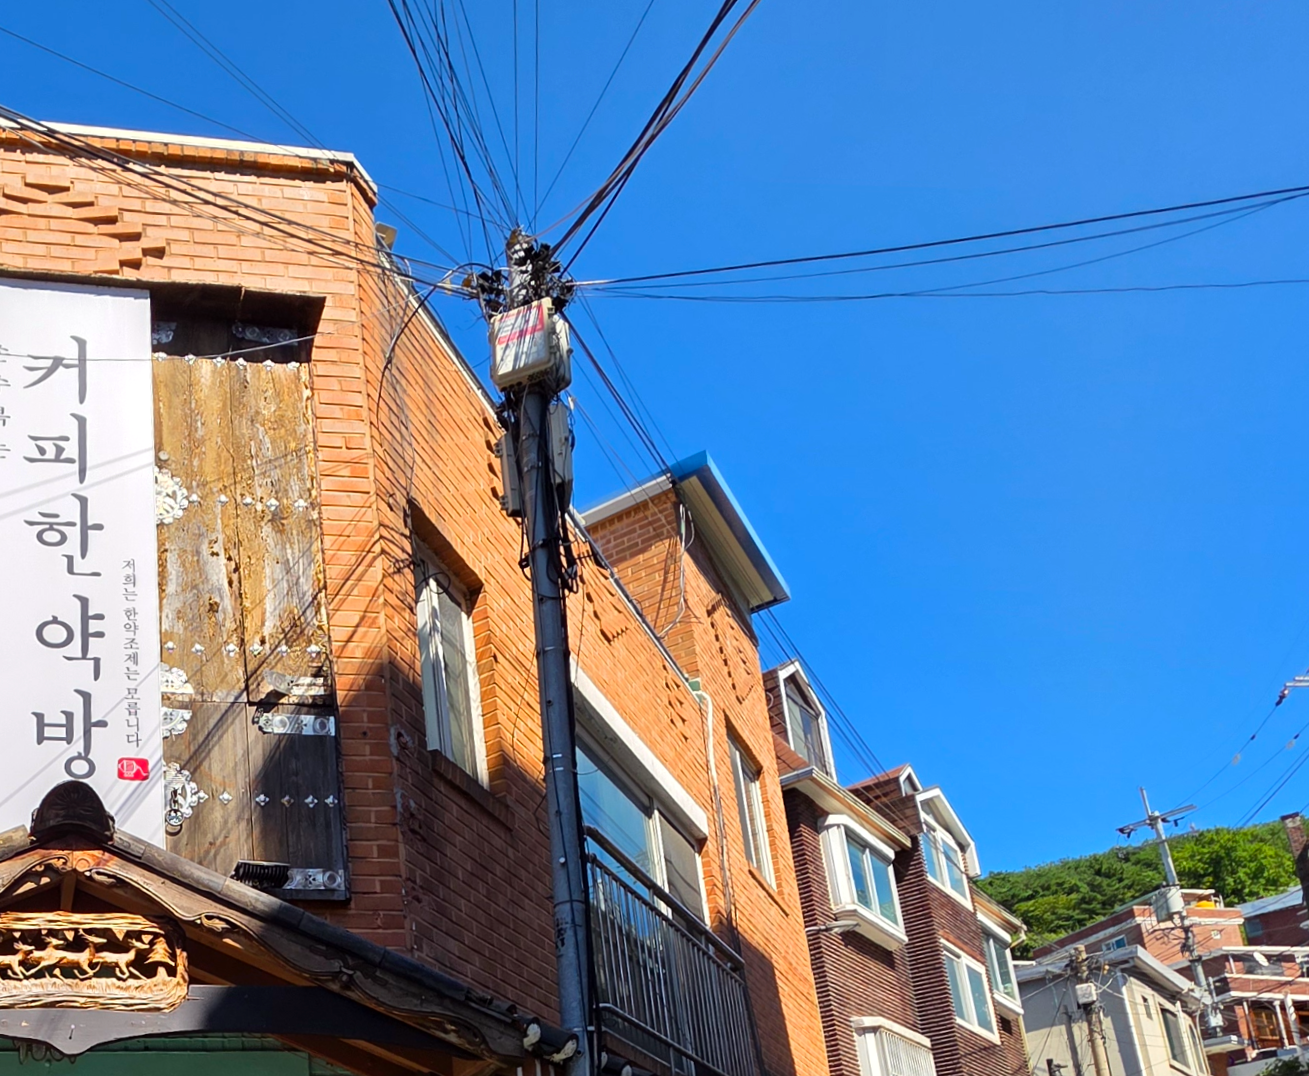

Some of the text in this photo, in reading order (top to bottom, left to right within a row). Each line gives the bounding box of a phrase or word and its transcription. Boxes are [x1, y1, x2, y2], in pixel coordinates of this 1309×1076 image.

[22, 335, 109, 780] 커피한약방
[122, 558, 138, 602] 저희는
[124, 687, 142, 748] 모릅니다
